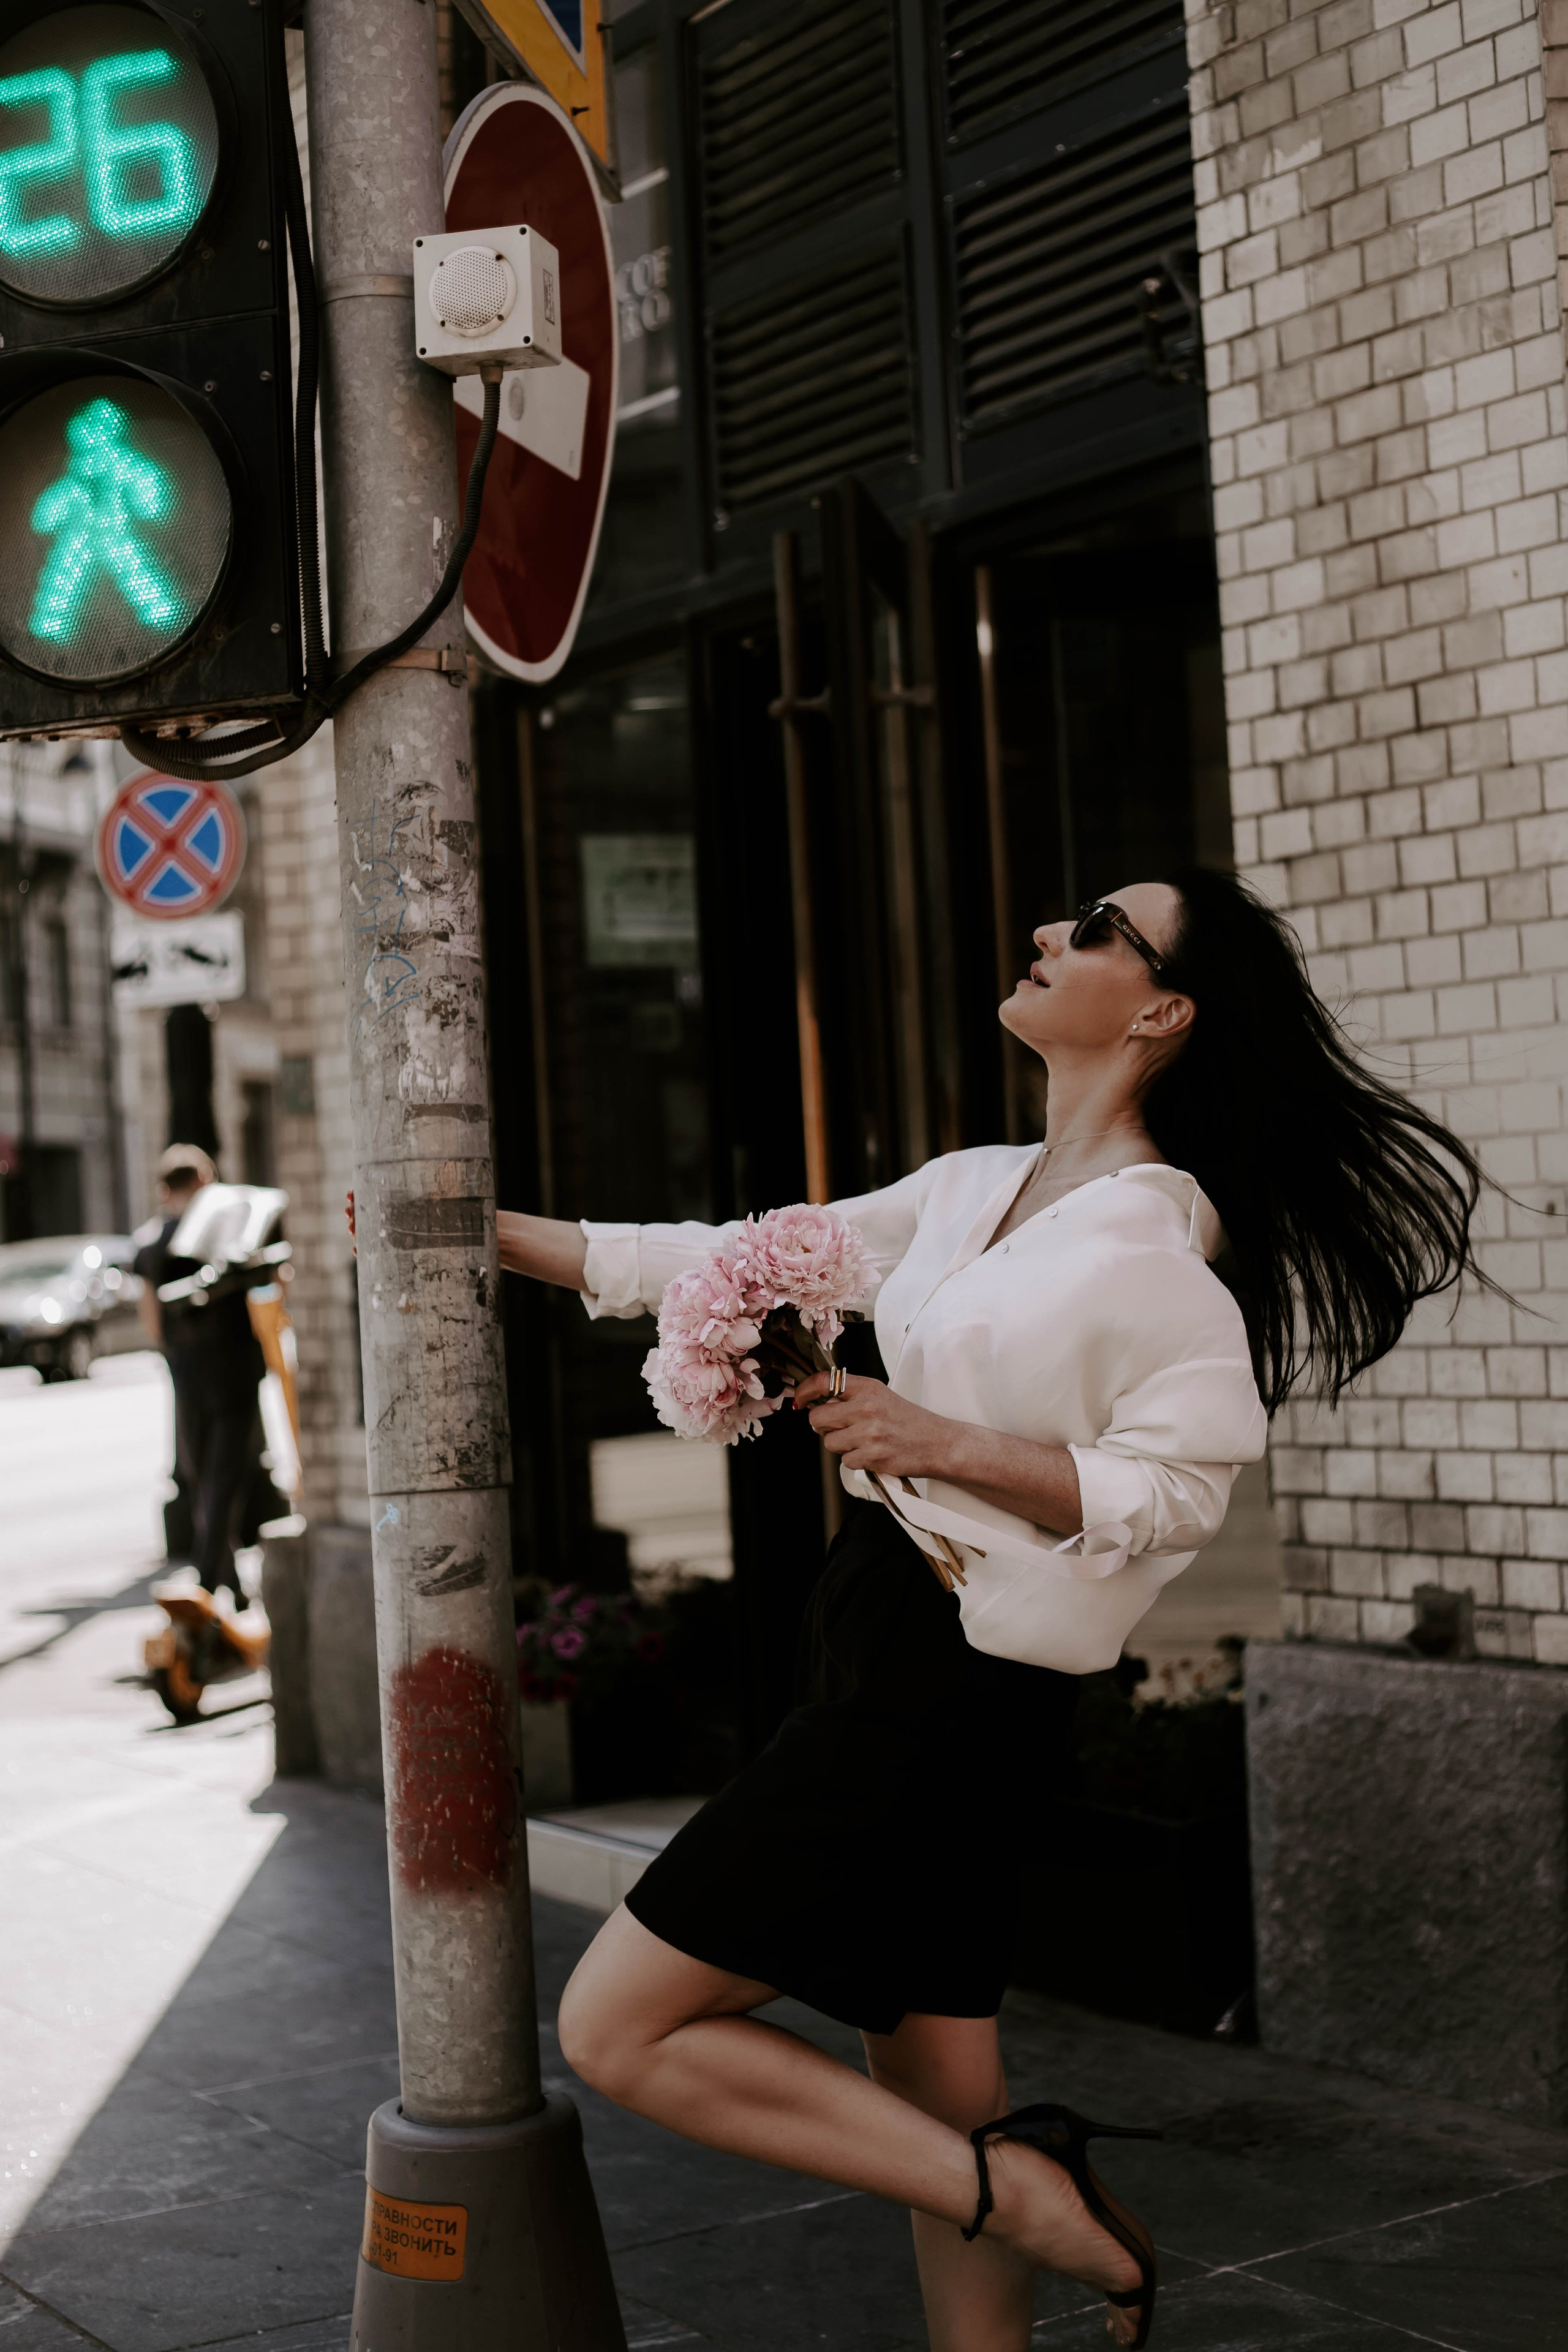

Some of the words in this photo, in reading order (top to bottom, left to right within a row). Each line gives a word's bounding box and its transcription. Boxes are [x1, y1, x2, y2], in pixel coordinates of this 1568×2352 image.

[0, 45, 195, 263] 26
[1122, 924, 1141, 944] GUCCI
[383, 2227, 457, 2256] ЗВОНИТЬ
